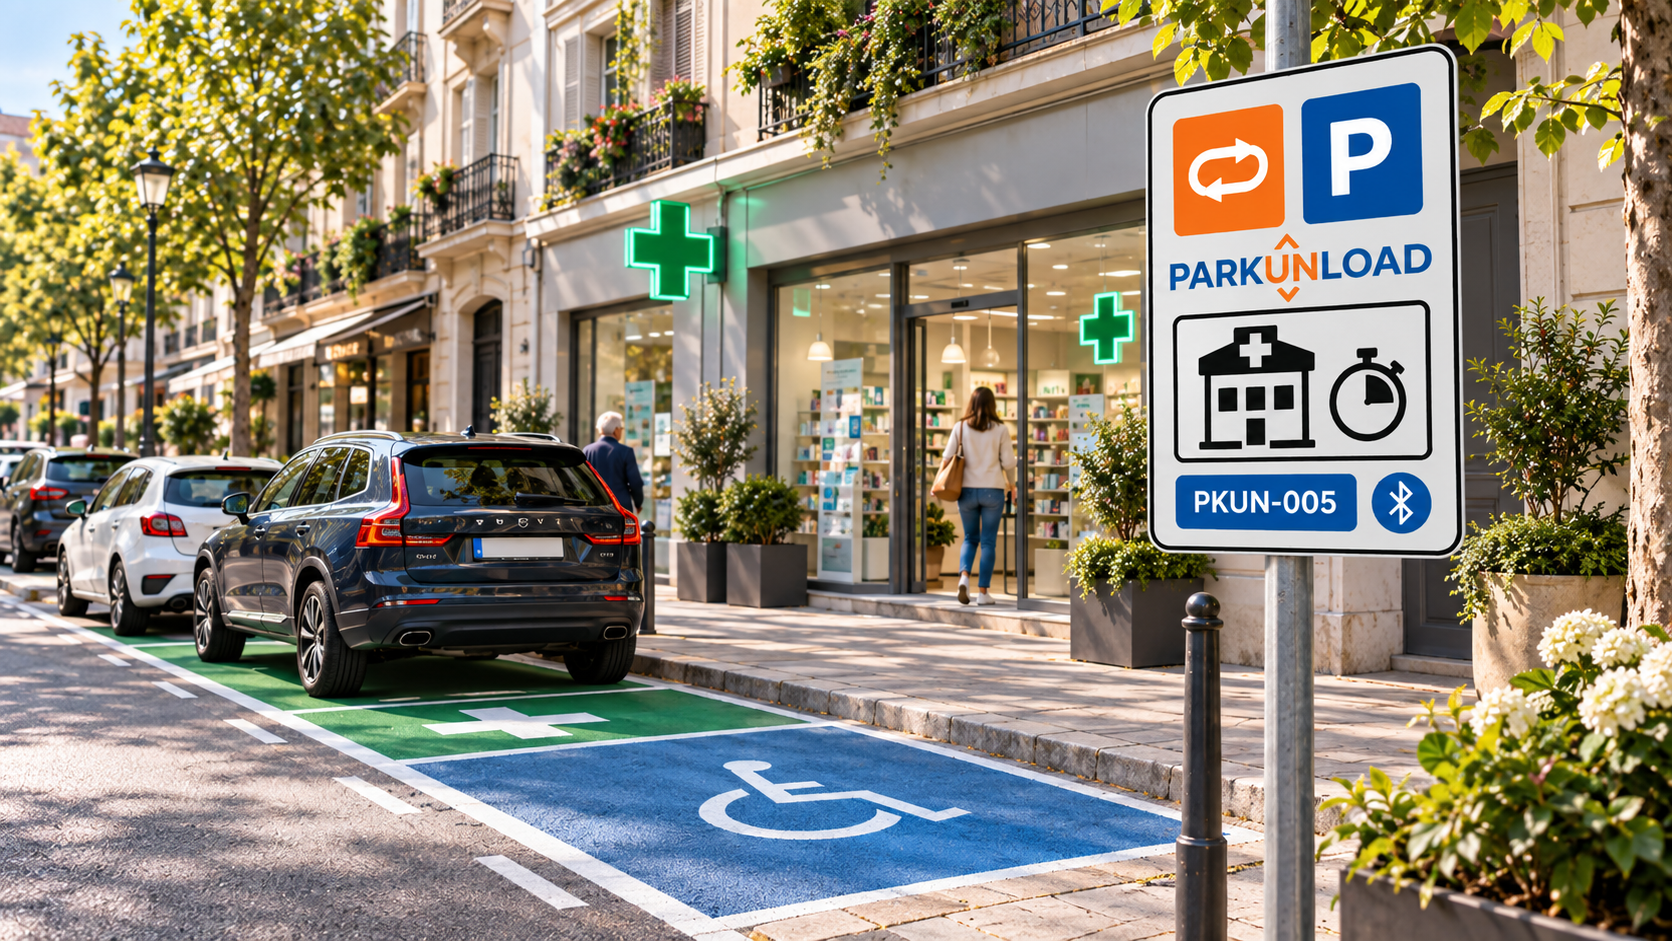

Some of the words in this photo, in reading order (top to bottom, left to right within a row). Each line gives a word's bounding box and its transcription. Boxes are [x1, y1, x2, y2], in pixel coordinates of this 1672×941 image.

[1330, 117, 1392, 197] P
[1169, 243, 1433, 291] PARKUNLOAD
[1194, 490, 1337, 514] PKUN-005
